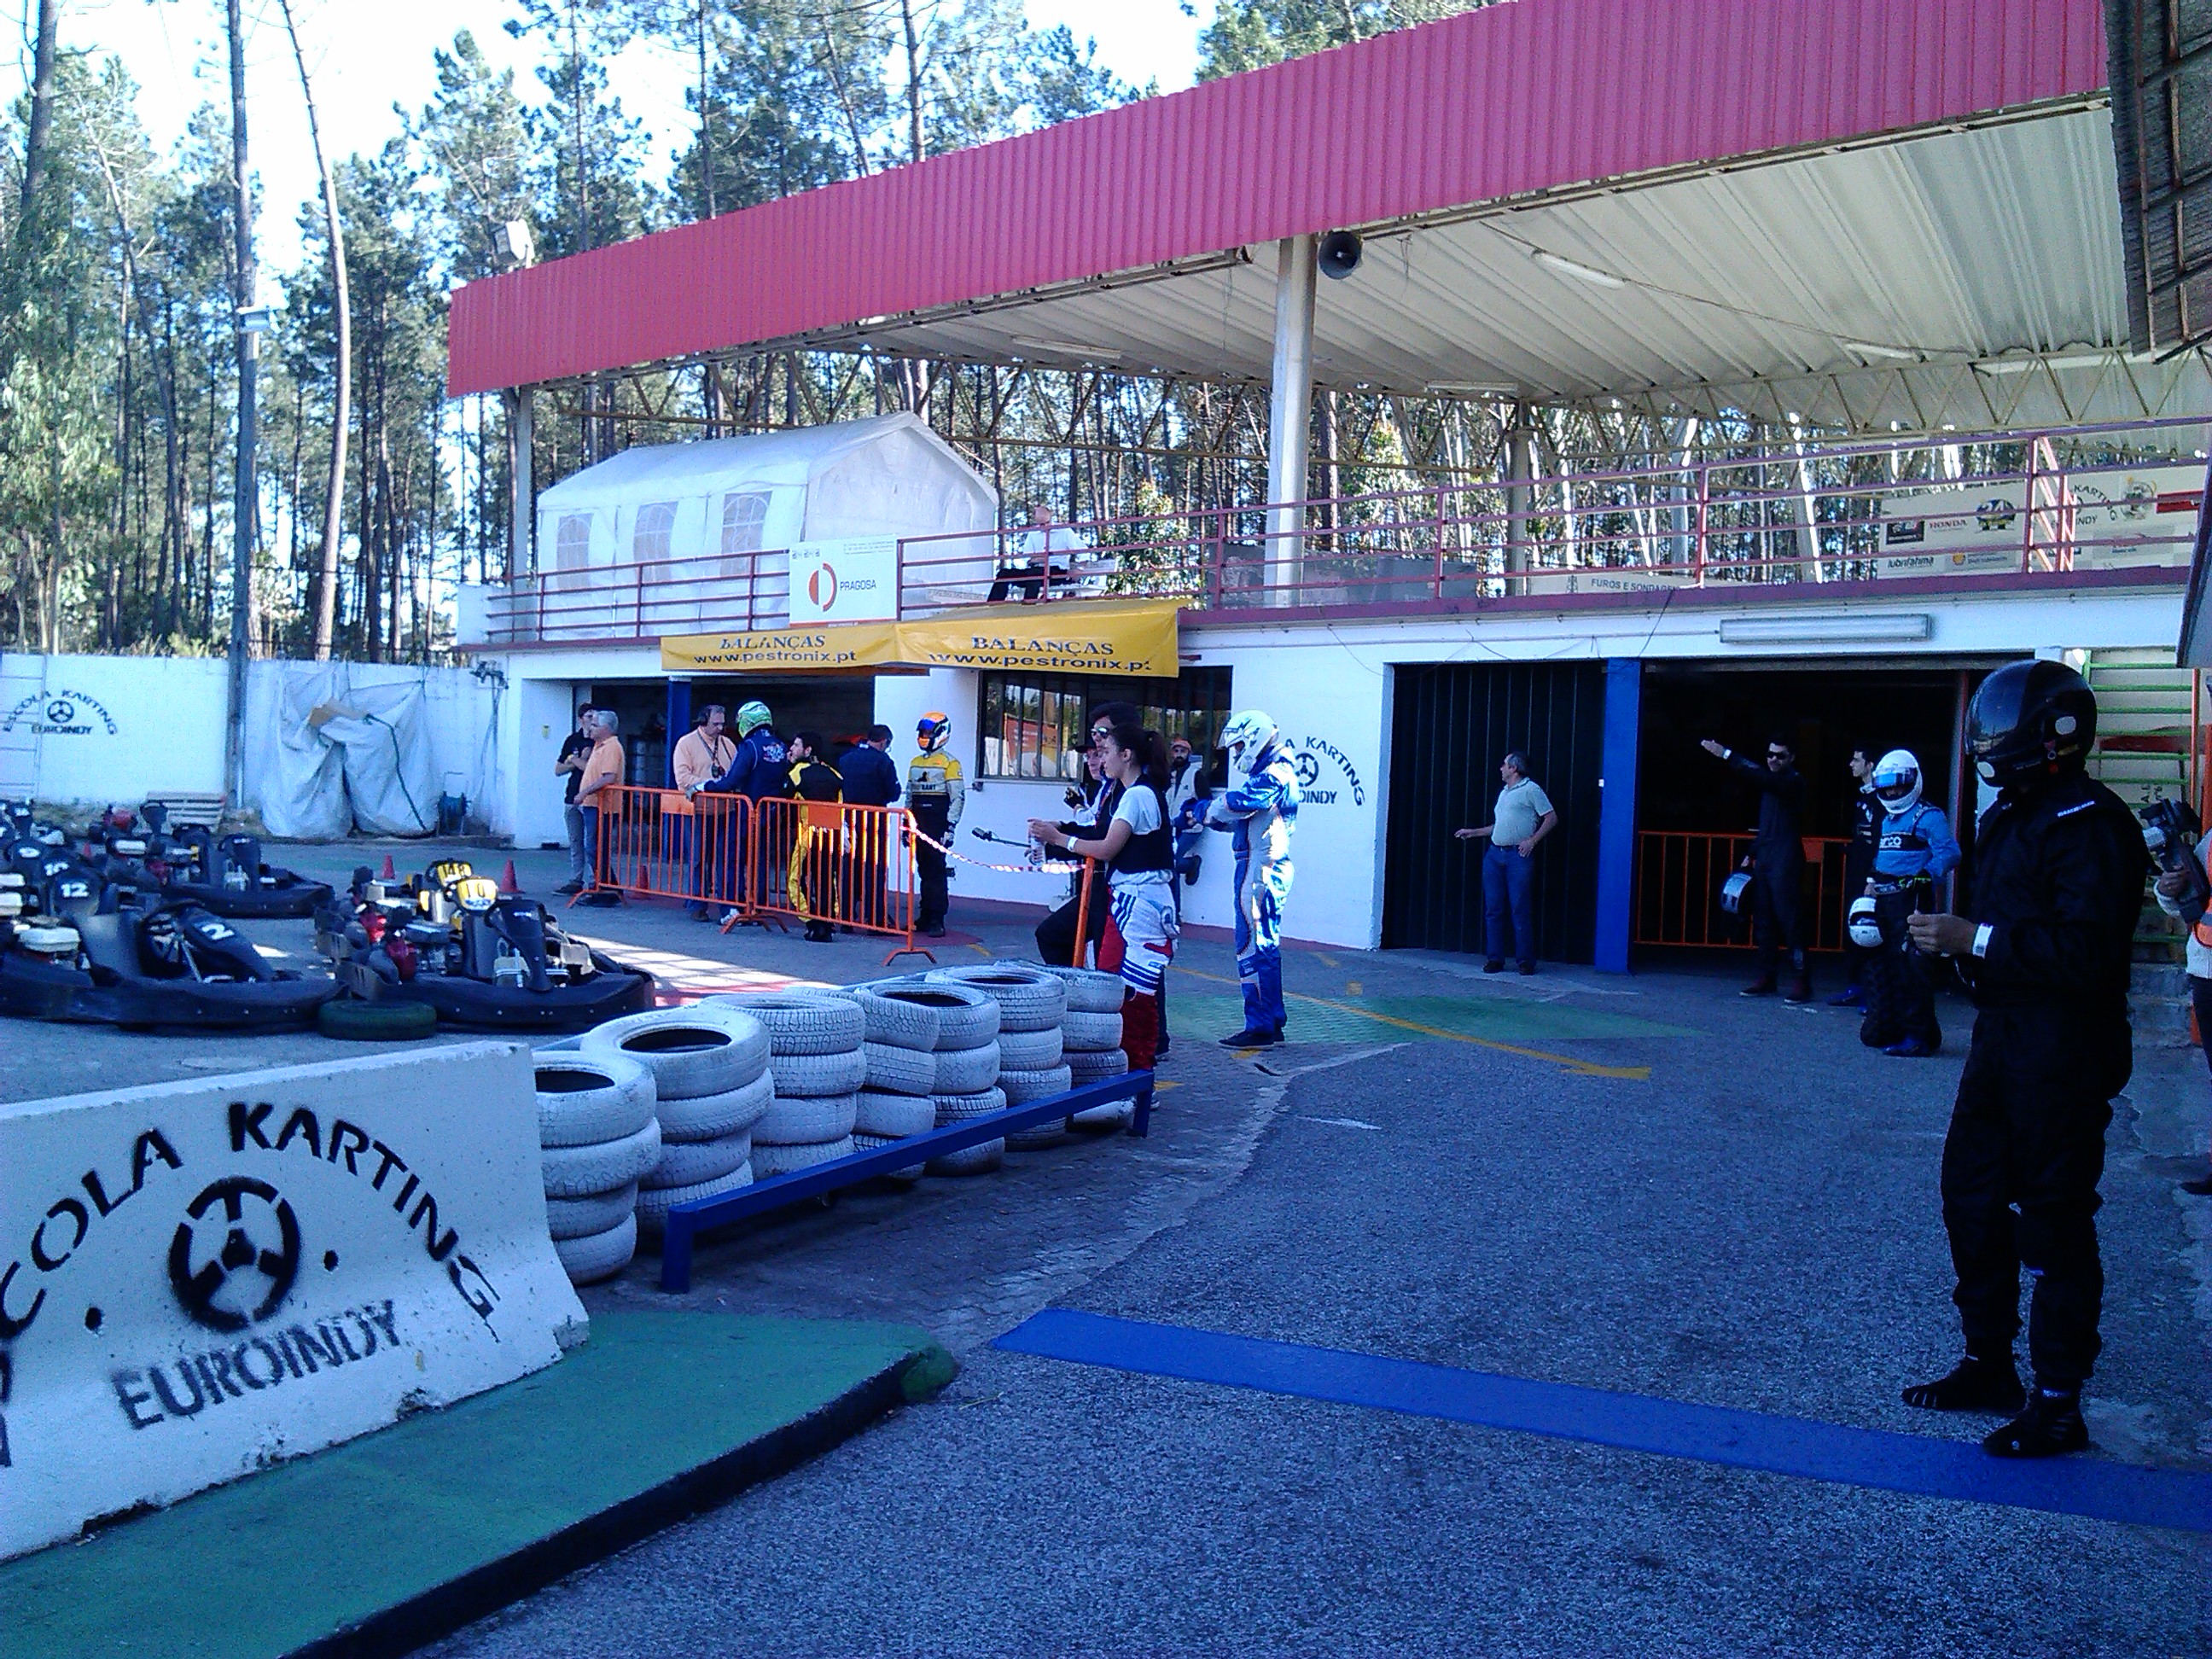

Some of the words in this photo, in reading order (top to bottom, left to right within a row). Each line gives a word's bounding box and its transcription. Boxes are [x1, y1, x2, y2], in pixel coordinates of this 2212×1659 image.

[1929, 519, 1968, 528] HONDA
[840, 579, 876, 591] PRAGOSA
[1591, 579, 1621, 589] FUROS
[1623, 582, 1629, 591] E
[719, 635, 826, 651] BALANÇAS
[970, 637, 1115, 656] BALANÇAS
[694, 650, 858, 664] www.pestronix.pt
[1306, 736, 1365, 806] KARTING
[61, 882, 89, 898] 12
[201, 923, 235, 940] 2
[227, 1102, 502, 1344] KARTING
[111, 1299, 401, 1430] EUROINDY
